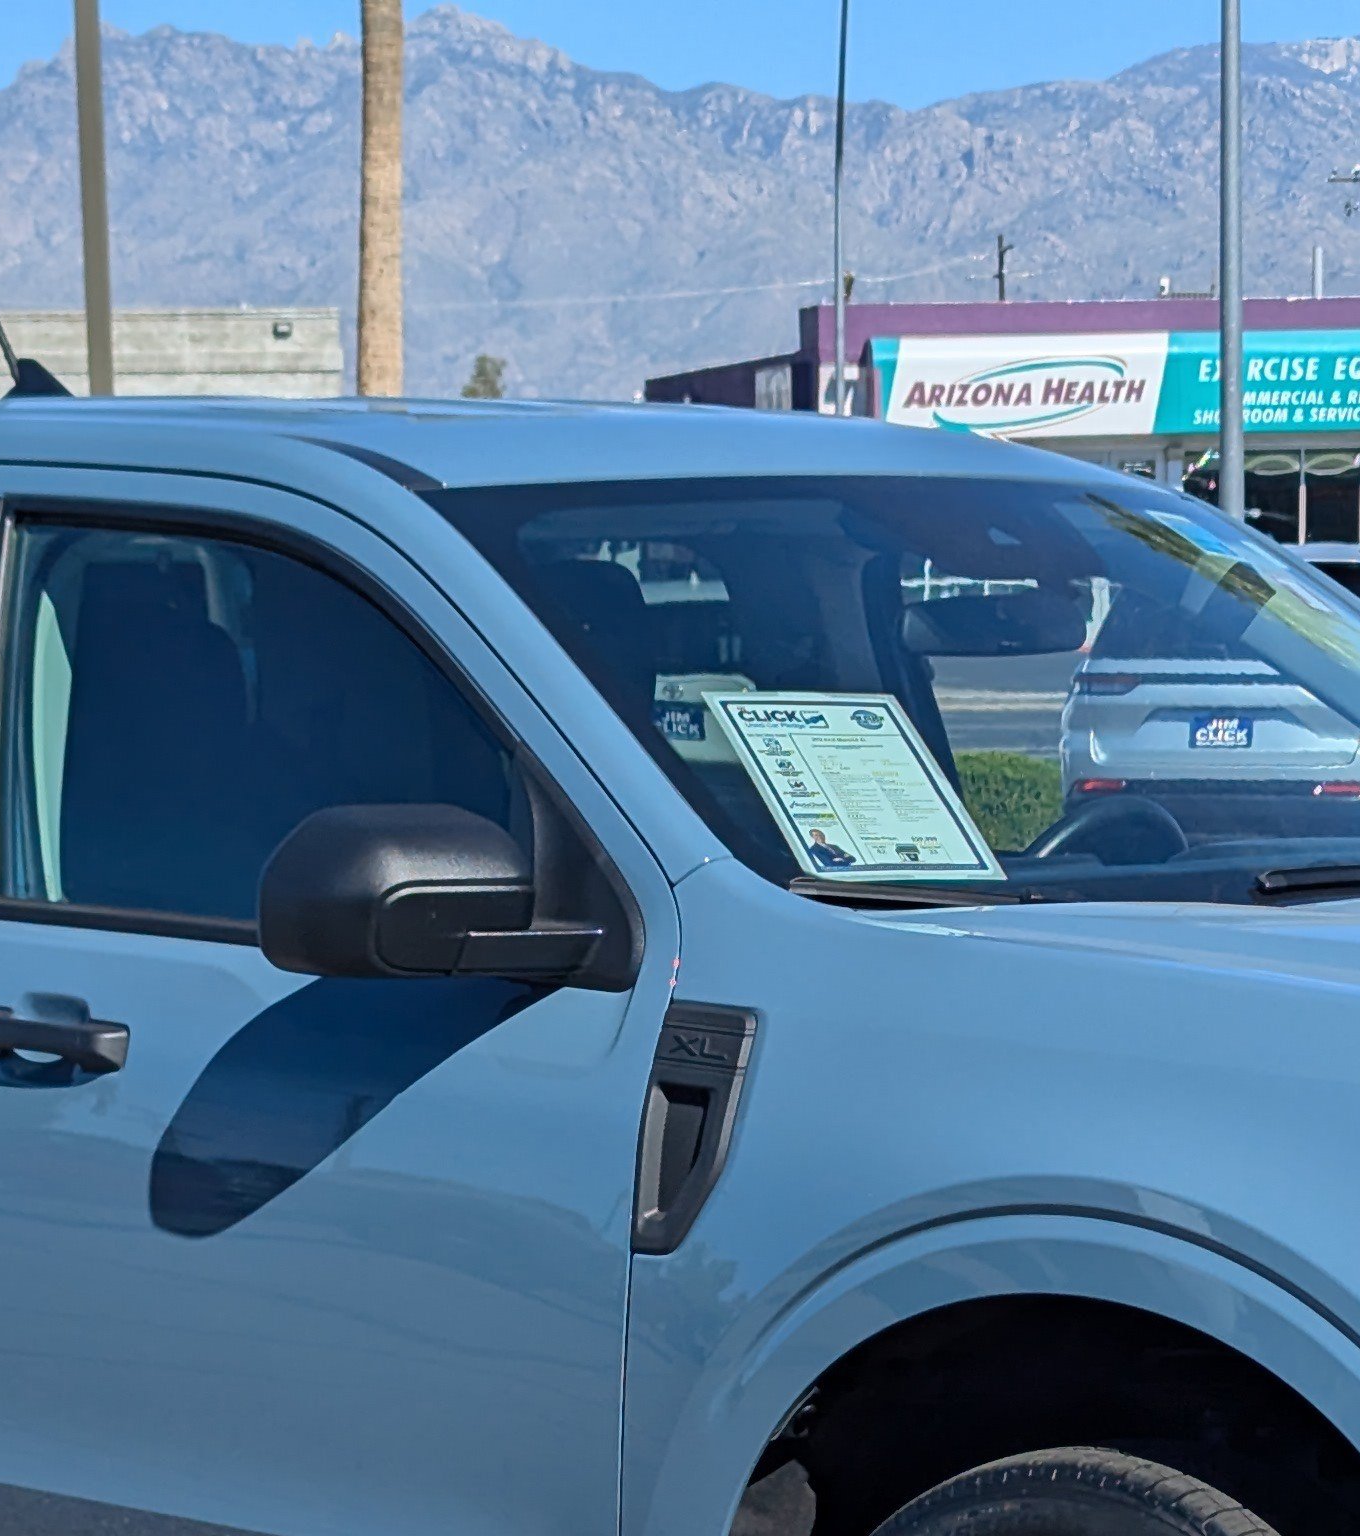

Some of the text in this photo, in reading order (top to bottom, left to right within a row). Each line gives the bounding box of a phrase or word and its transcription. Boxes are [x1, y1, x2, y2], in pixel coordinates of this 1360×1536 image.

[1198, 356, 1321, 383] EXRCISE
[902, 377, 1147, 409] ARIZONA HEALTH
[1241, 389, 1325, 406] MMERCIAL
[1329, 390, 1342, 405] &
[1192, 407, 1289, 425] SHOROOM
[1292, 407, 1305, 423] &
[738, 709, 802, 722] CLICK
[1207, 718, 1240, 730] JIM
[1195, 727, 1249, 741] CLICK
[669, 1034, 728, 1061] XL
